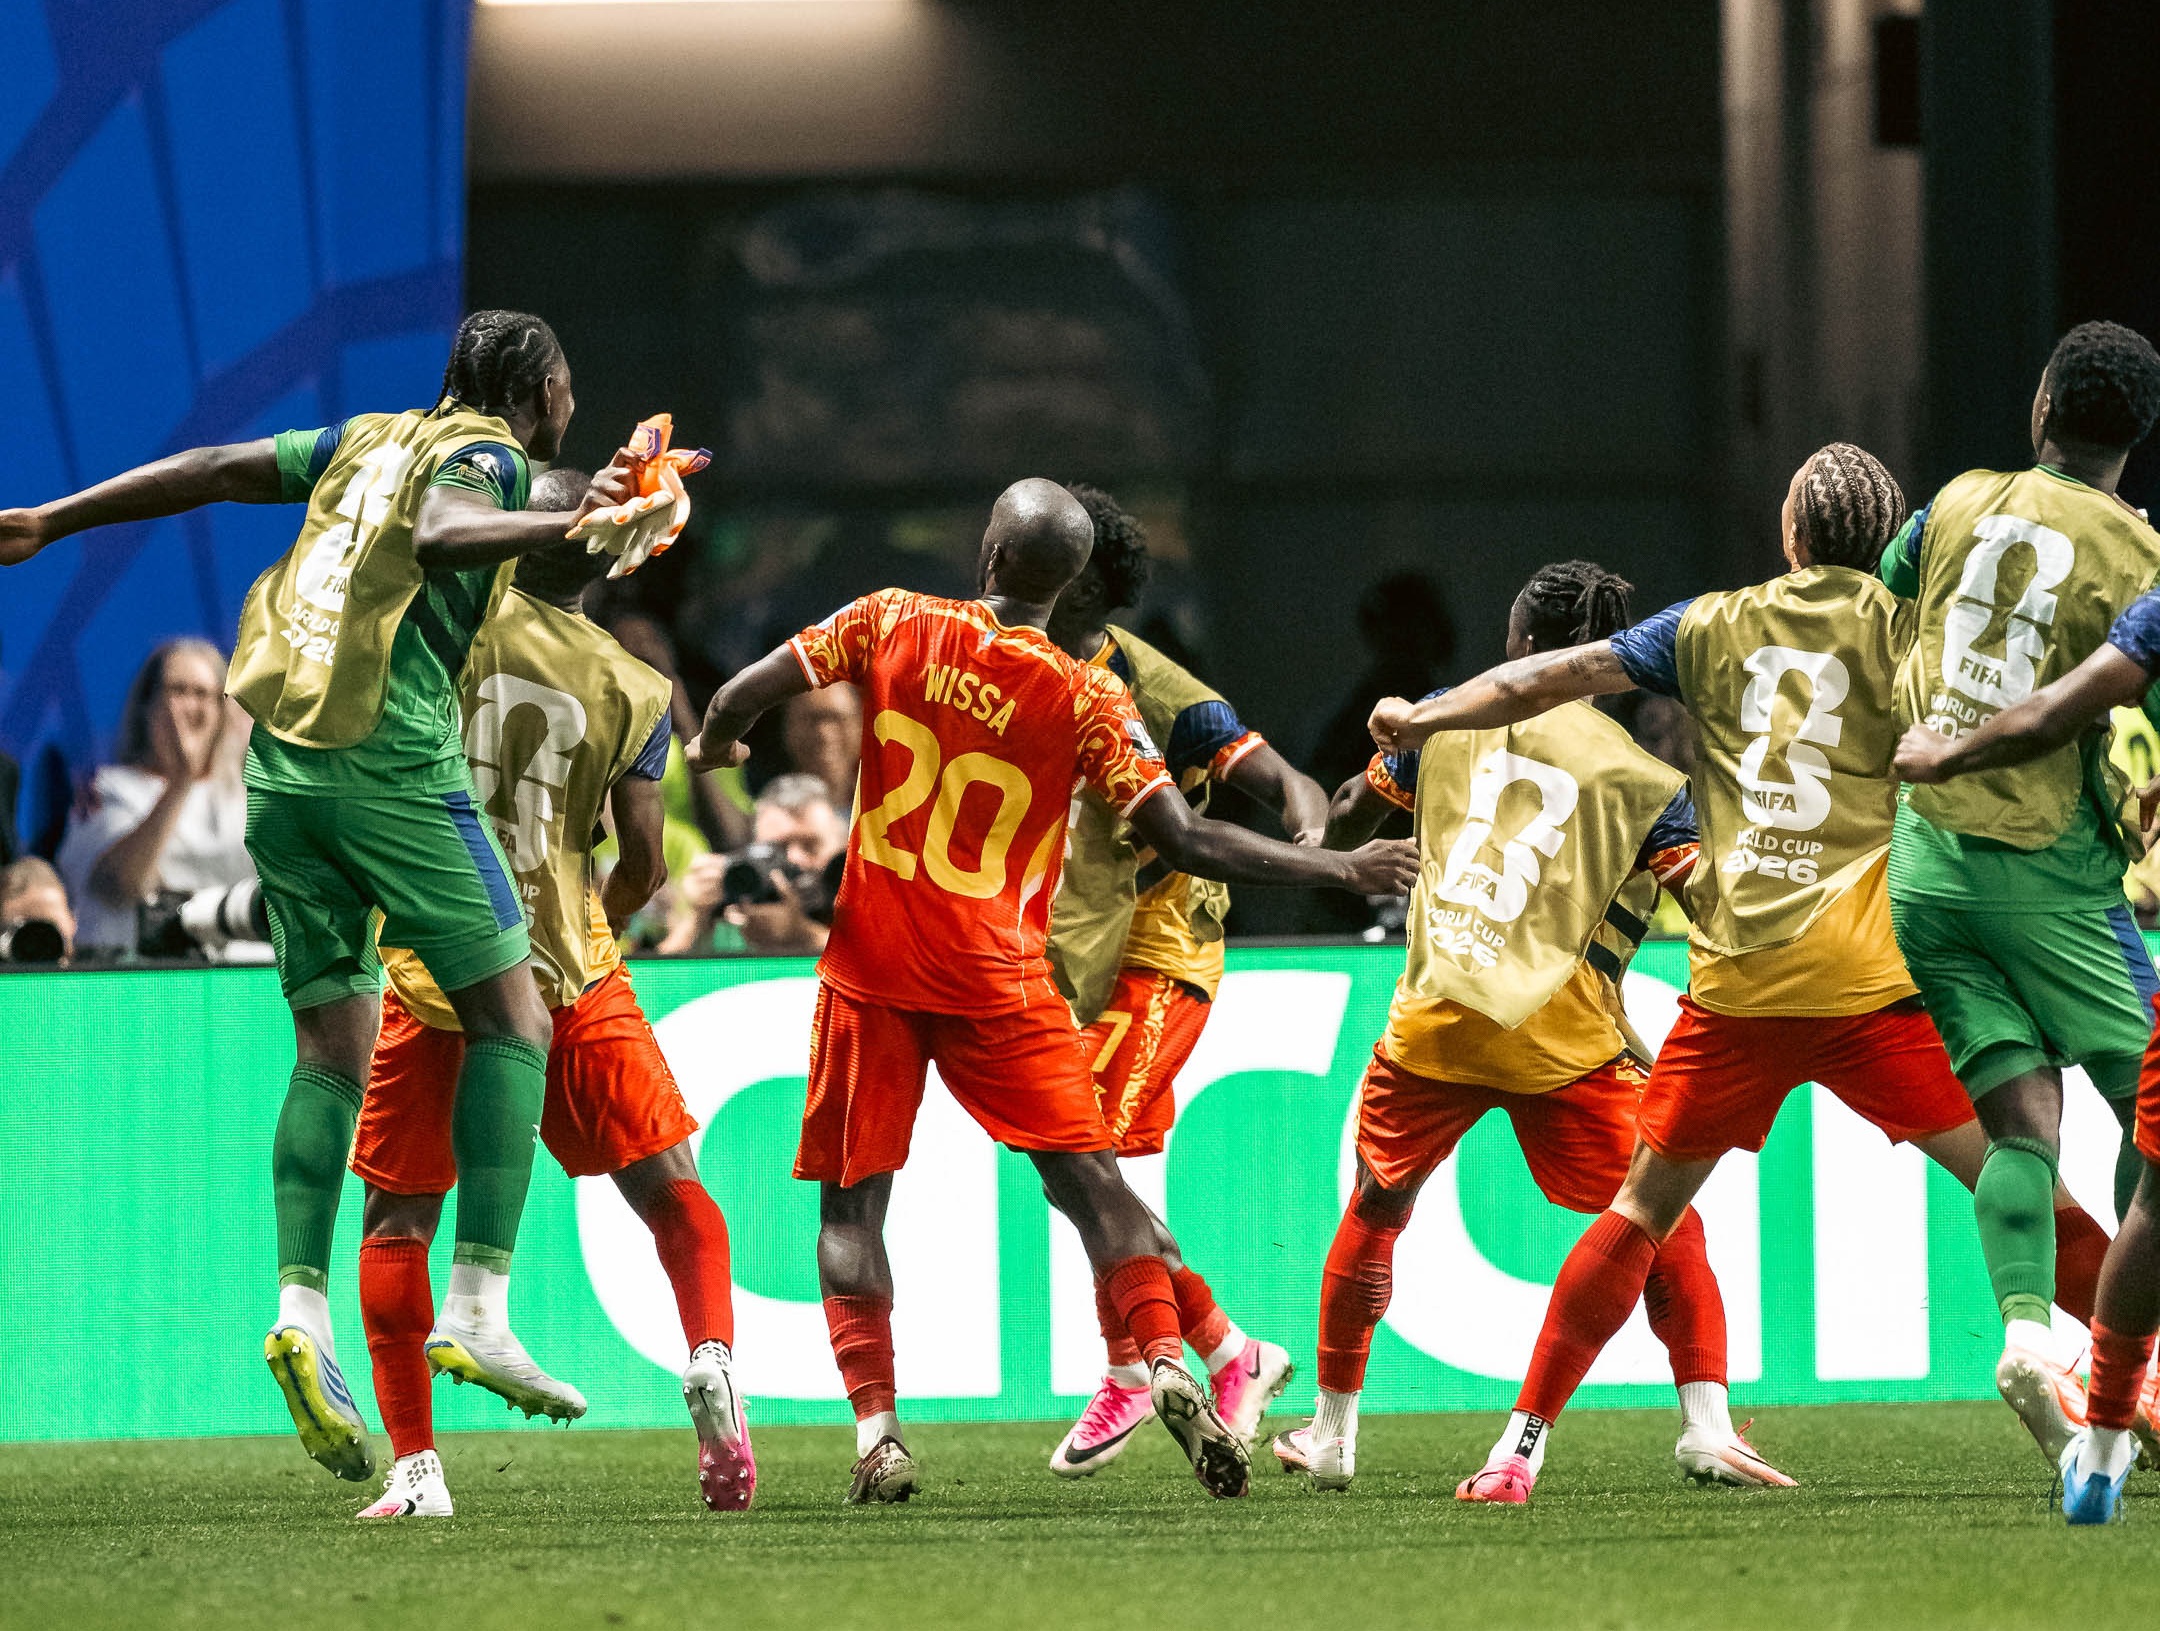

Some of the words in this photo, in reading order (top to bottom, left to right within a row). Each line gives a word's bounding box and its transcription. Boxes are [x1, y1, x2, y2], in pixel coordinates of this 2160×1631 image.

[1959, 656, 2002, 690] FIFA
[924, 663, 1017, 738] WISSA
[858, 709, 1034, 900] 20
[1782, 838, 1824, 856] CUP
[1456, 870, 1498, 902] FIFA
[1472, 919, 1506, 948] CUP
